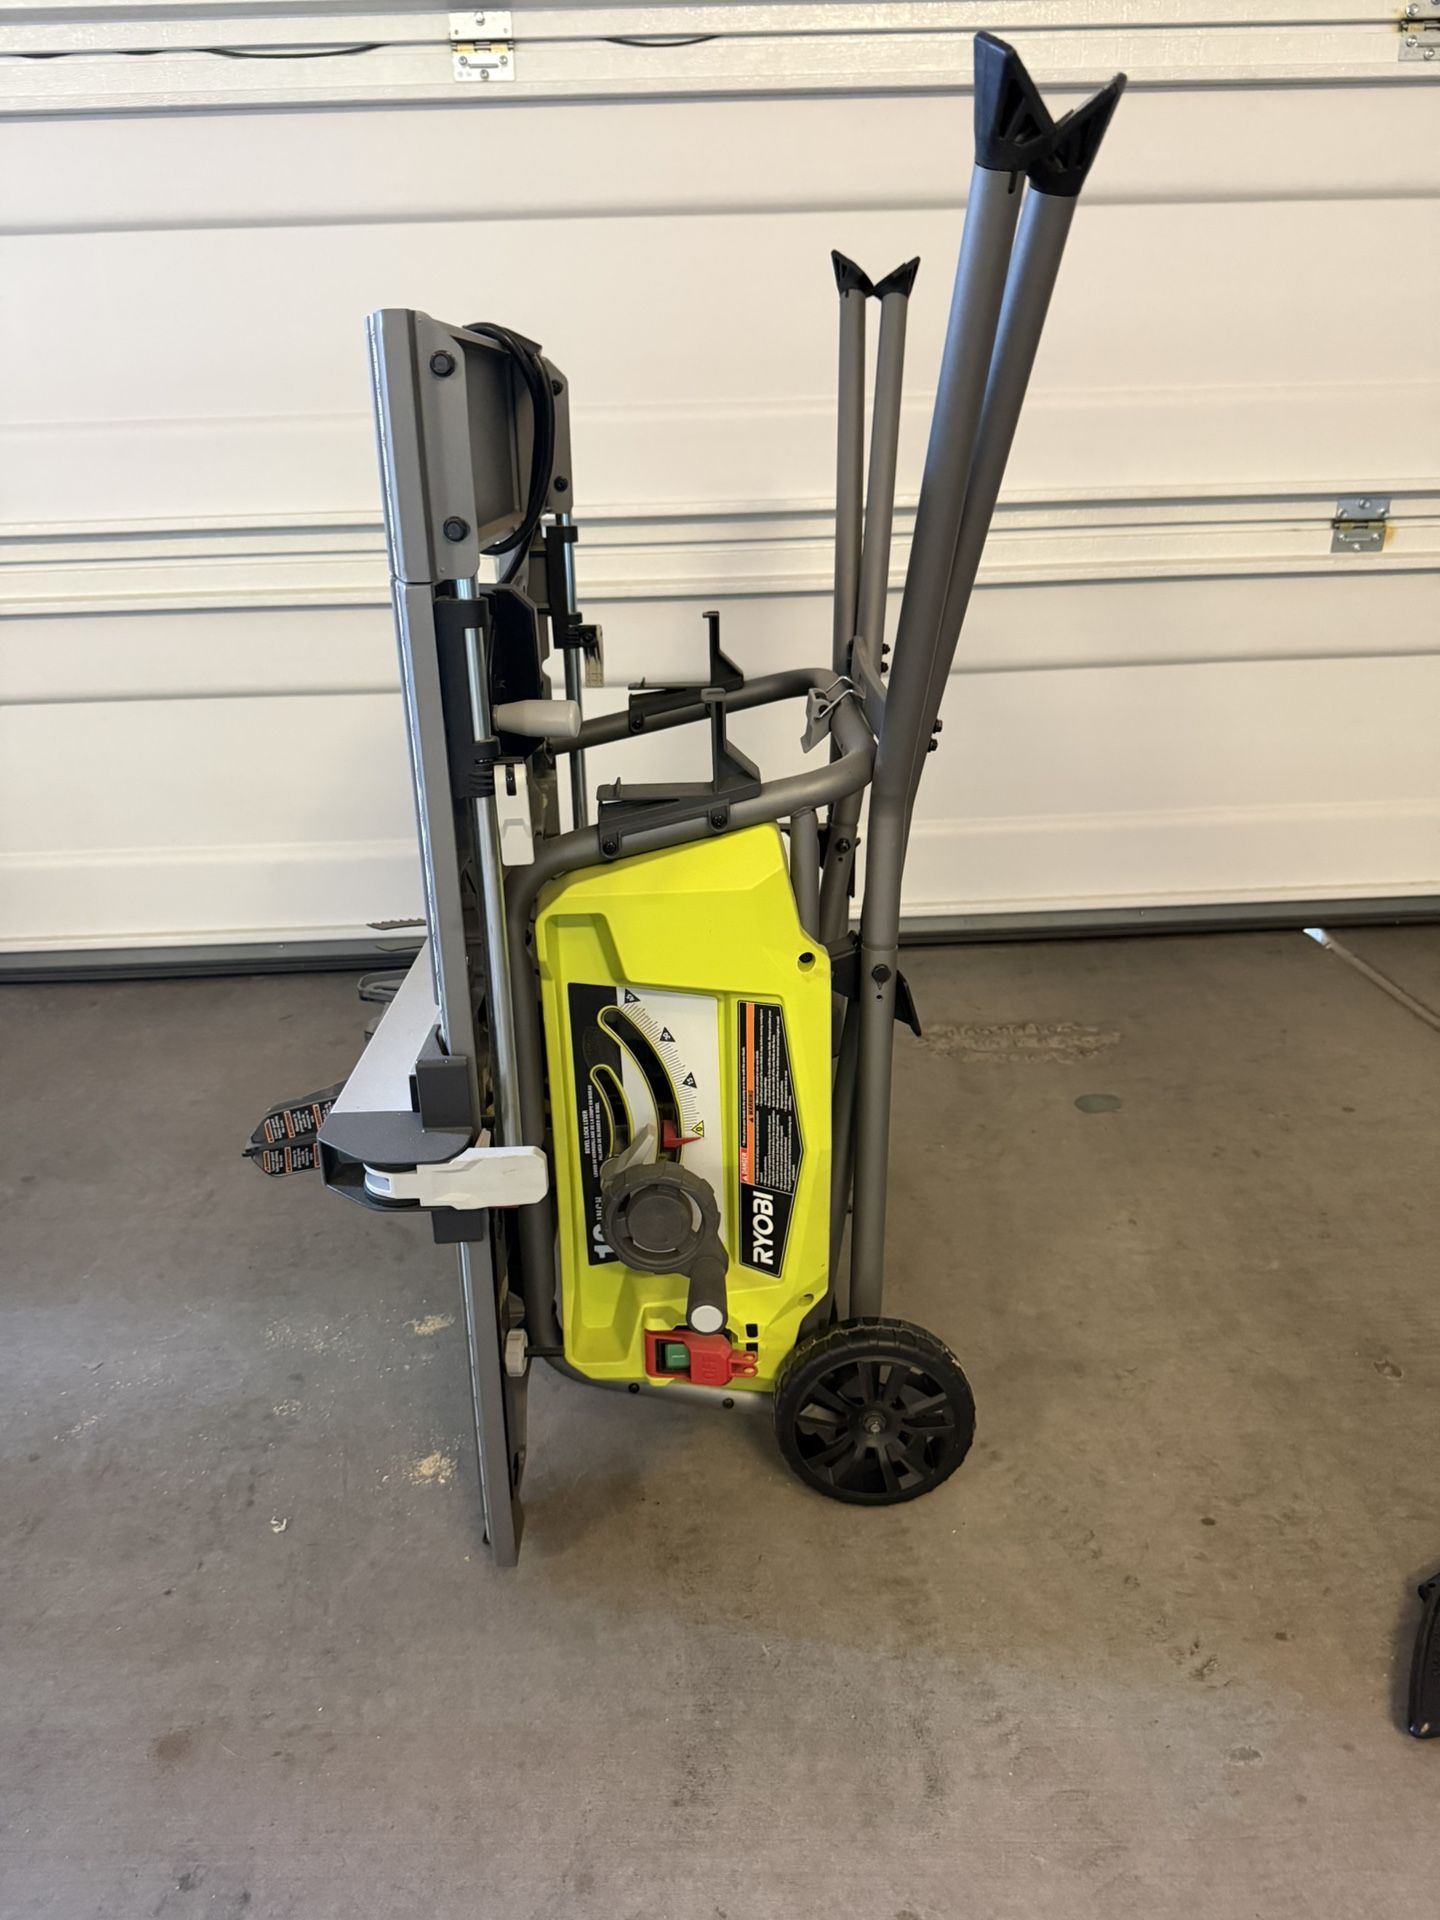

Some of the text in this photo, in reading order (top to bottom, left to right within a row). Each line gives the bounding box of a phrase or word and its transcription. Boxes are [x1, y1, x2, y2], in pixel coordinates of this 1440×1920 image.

[663, 1032, 671, 1041] 30
[686, 1077, 694, 1085] 15
[583, 1140, 591, 1155] BEVEL
[752, 1190, 774, 1266] RYOBI
